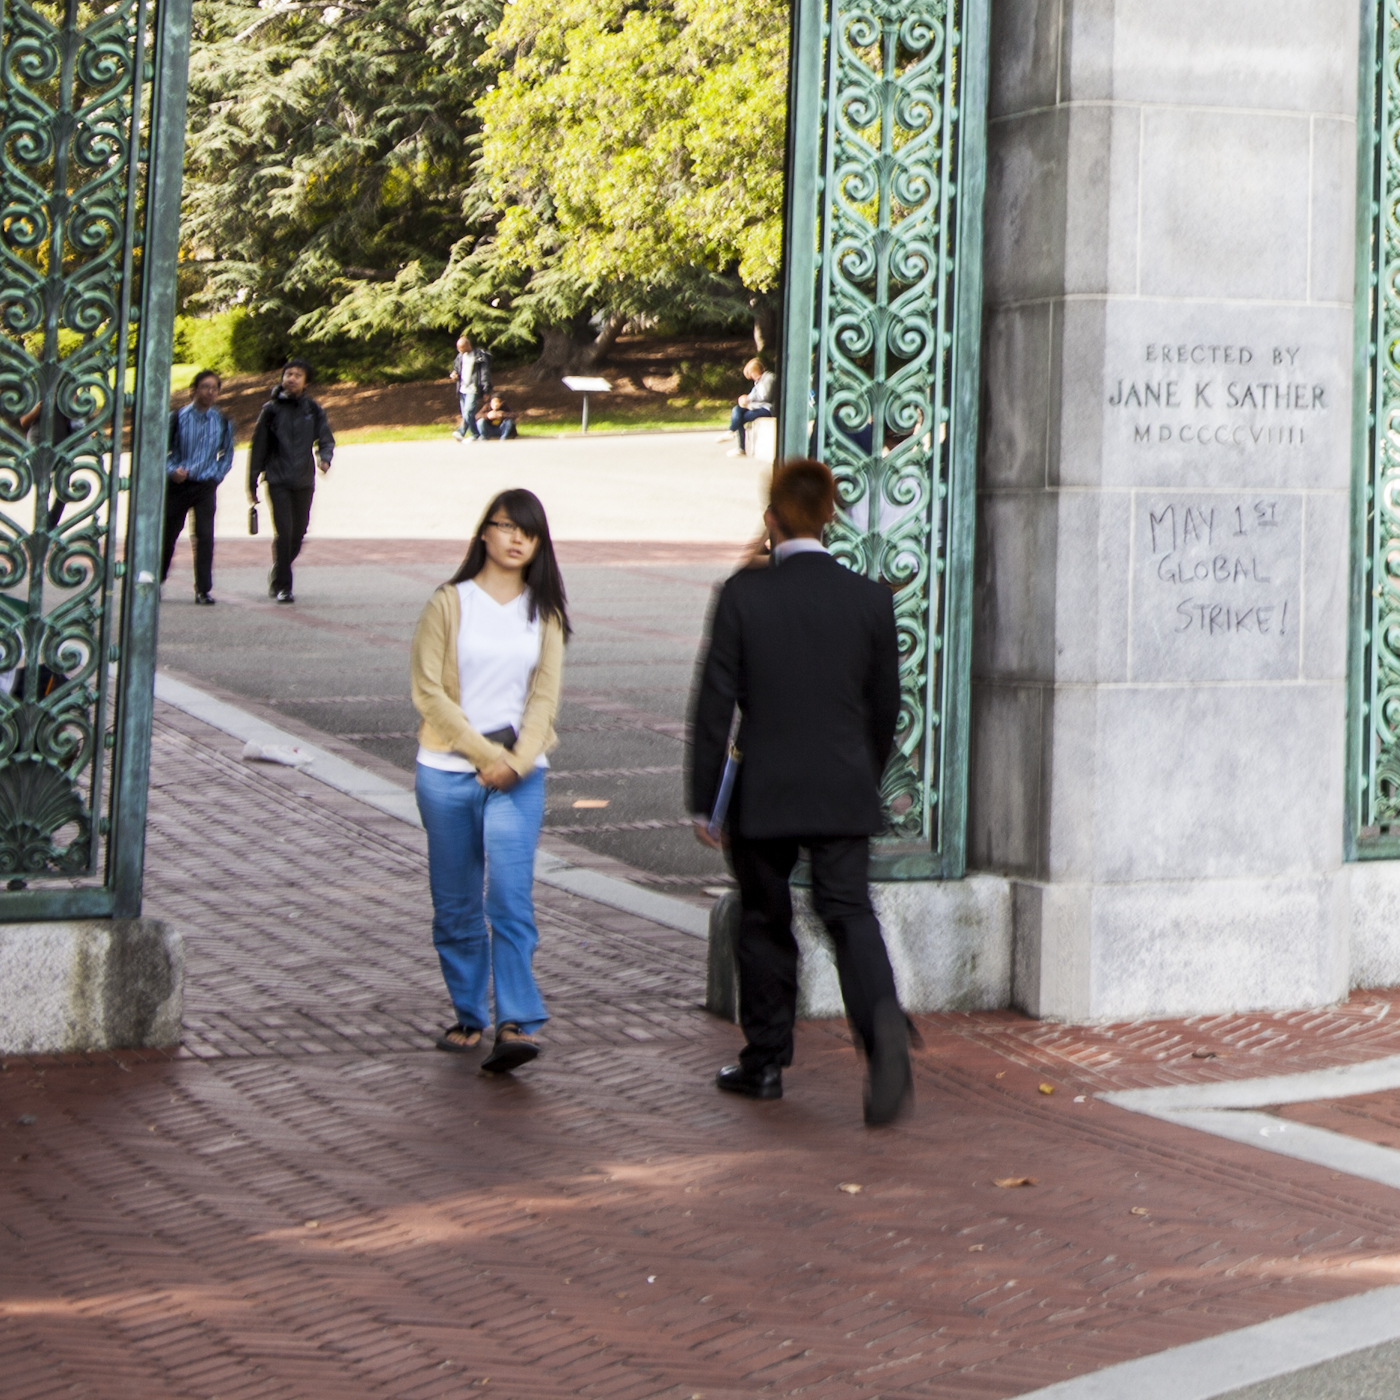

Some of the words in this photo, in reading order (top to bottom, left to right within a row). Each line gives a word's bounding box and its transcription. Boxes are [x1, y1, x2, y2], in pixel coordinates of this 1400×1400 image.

[1145, 343, 1253, 365] ERECTED
[1272, 346, 1300, 365] BY
[1108, 379, 1180, 409] JANE
[1194, 380, 1213, 409] K
[1226, 381, 1329, 410] SATHER
[1149, 503, 1215, 554] MAY
[1157, 553, 1271, 585] GLOBAL
[1174, 596, 1289, 636] STRIKE!
